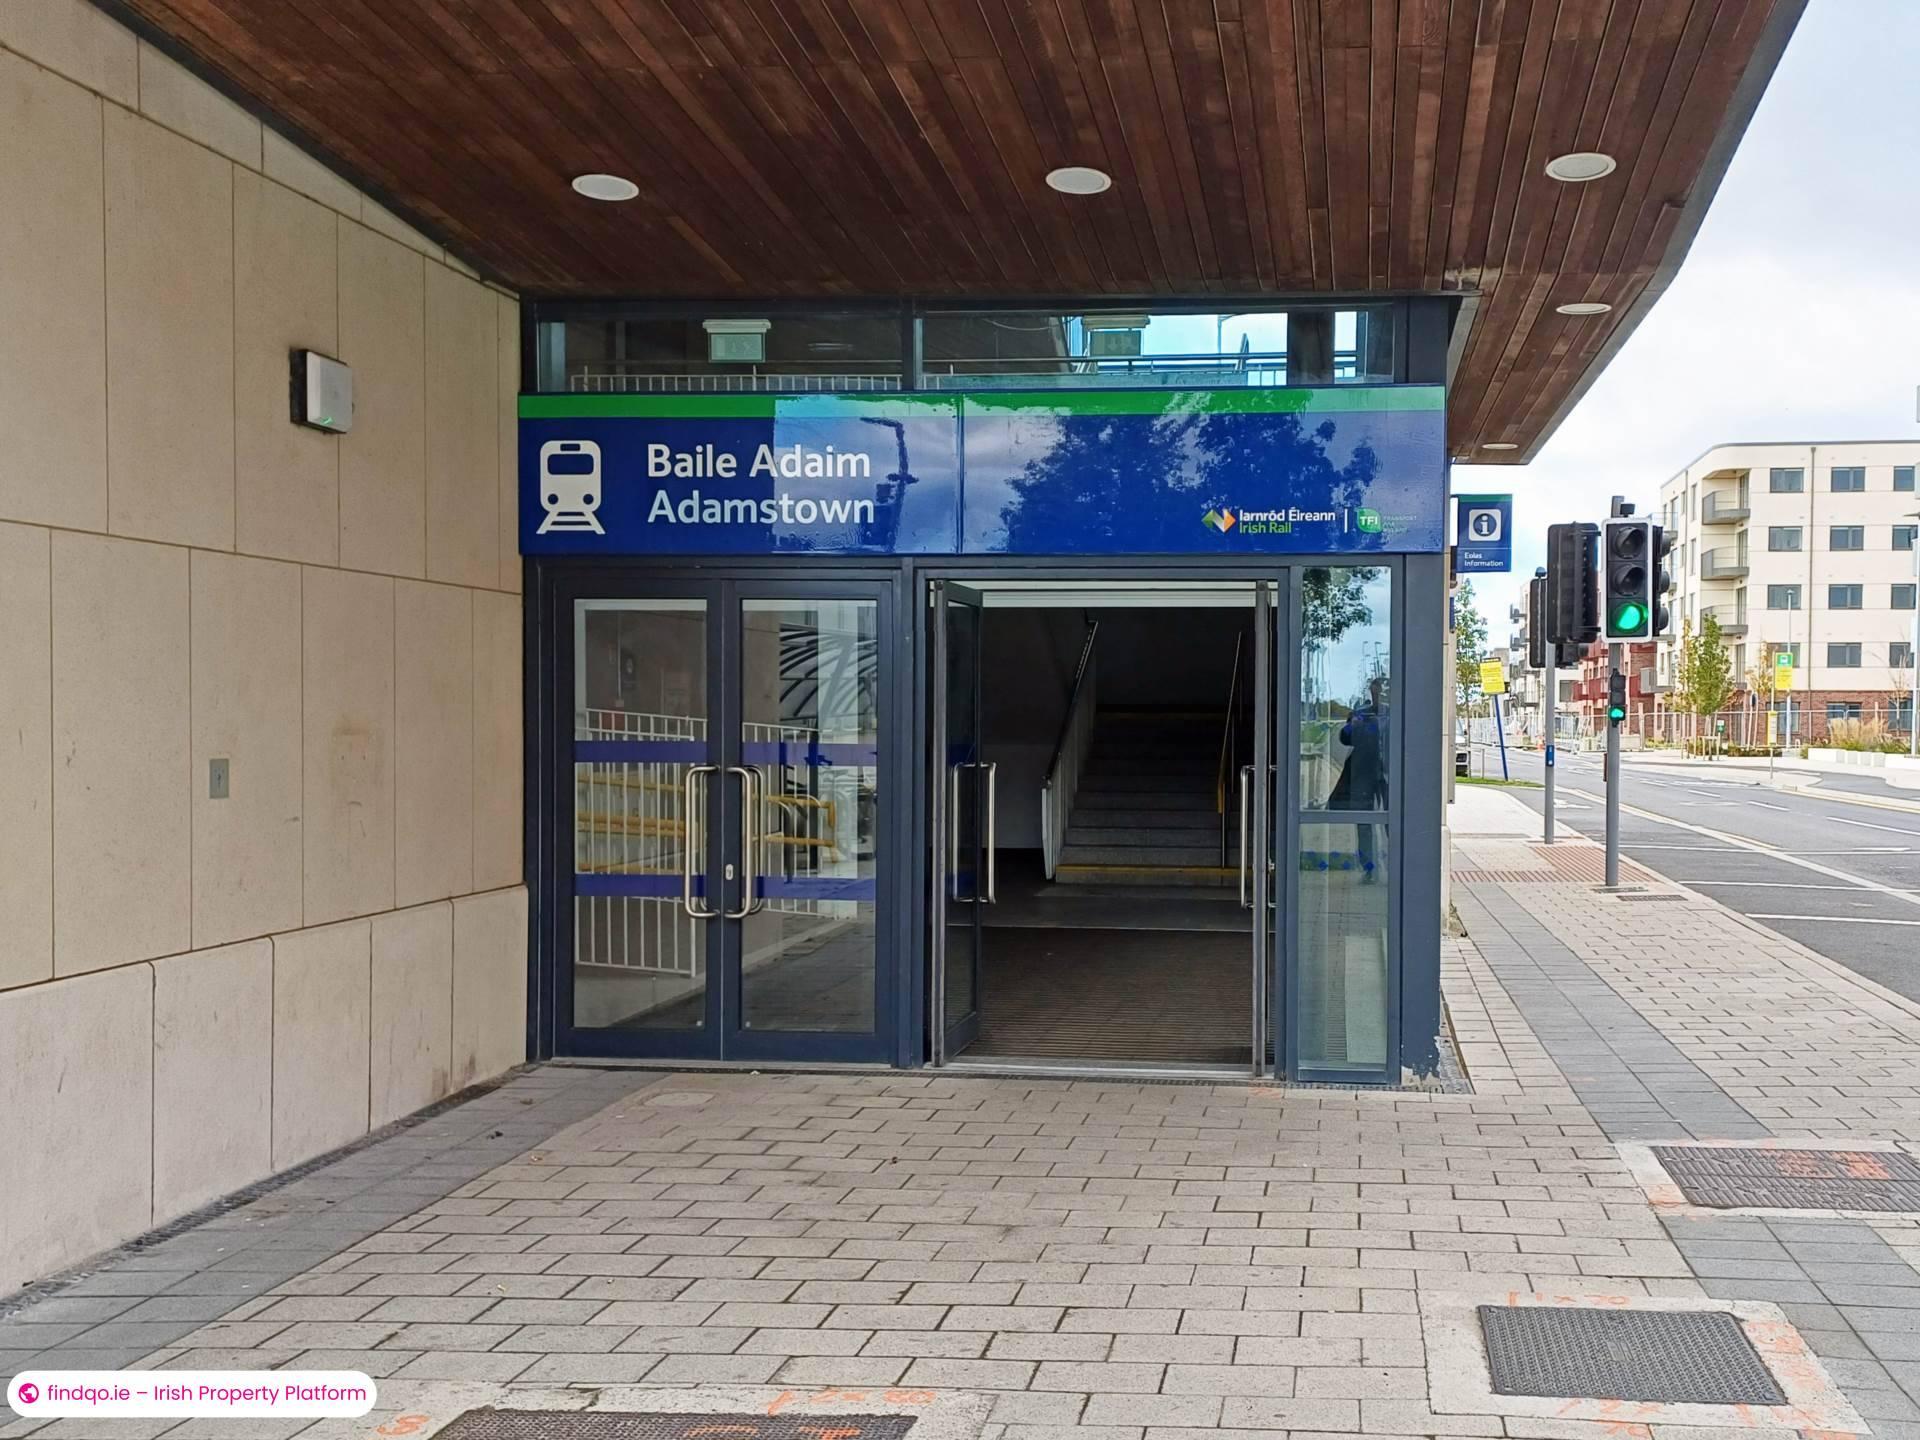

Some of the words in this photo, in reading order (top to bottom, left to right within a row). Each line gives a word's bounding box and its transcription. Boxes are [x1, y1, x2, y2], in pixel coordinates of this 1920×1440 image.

[647, 443, 736, 478] Baile
[749, 443, 870, 478] Adaim
[647, 490, 875, 524] Adamstown
[1239, 509, 1285, 522] Iarnród
[1359, 515, 1378, 526] TFI
[1239, 521, 1266, 534] Irish
[1269, 521, 1292, 534] Rail
